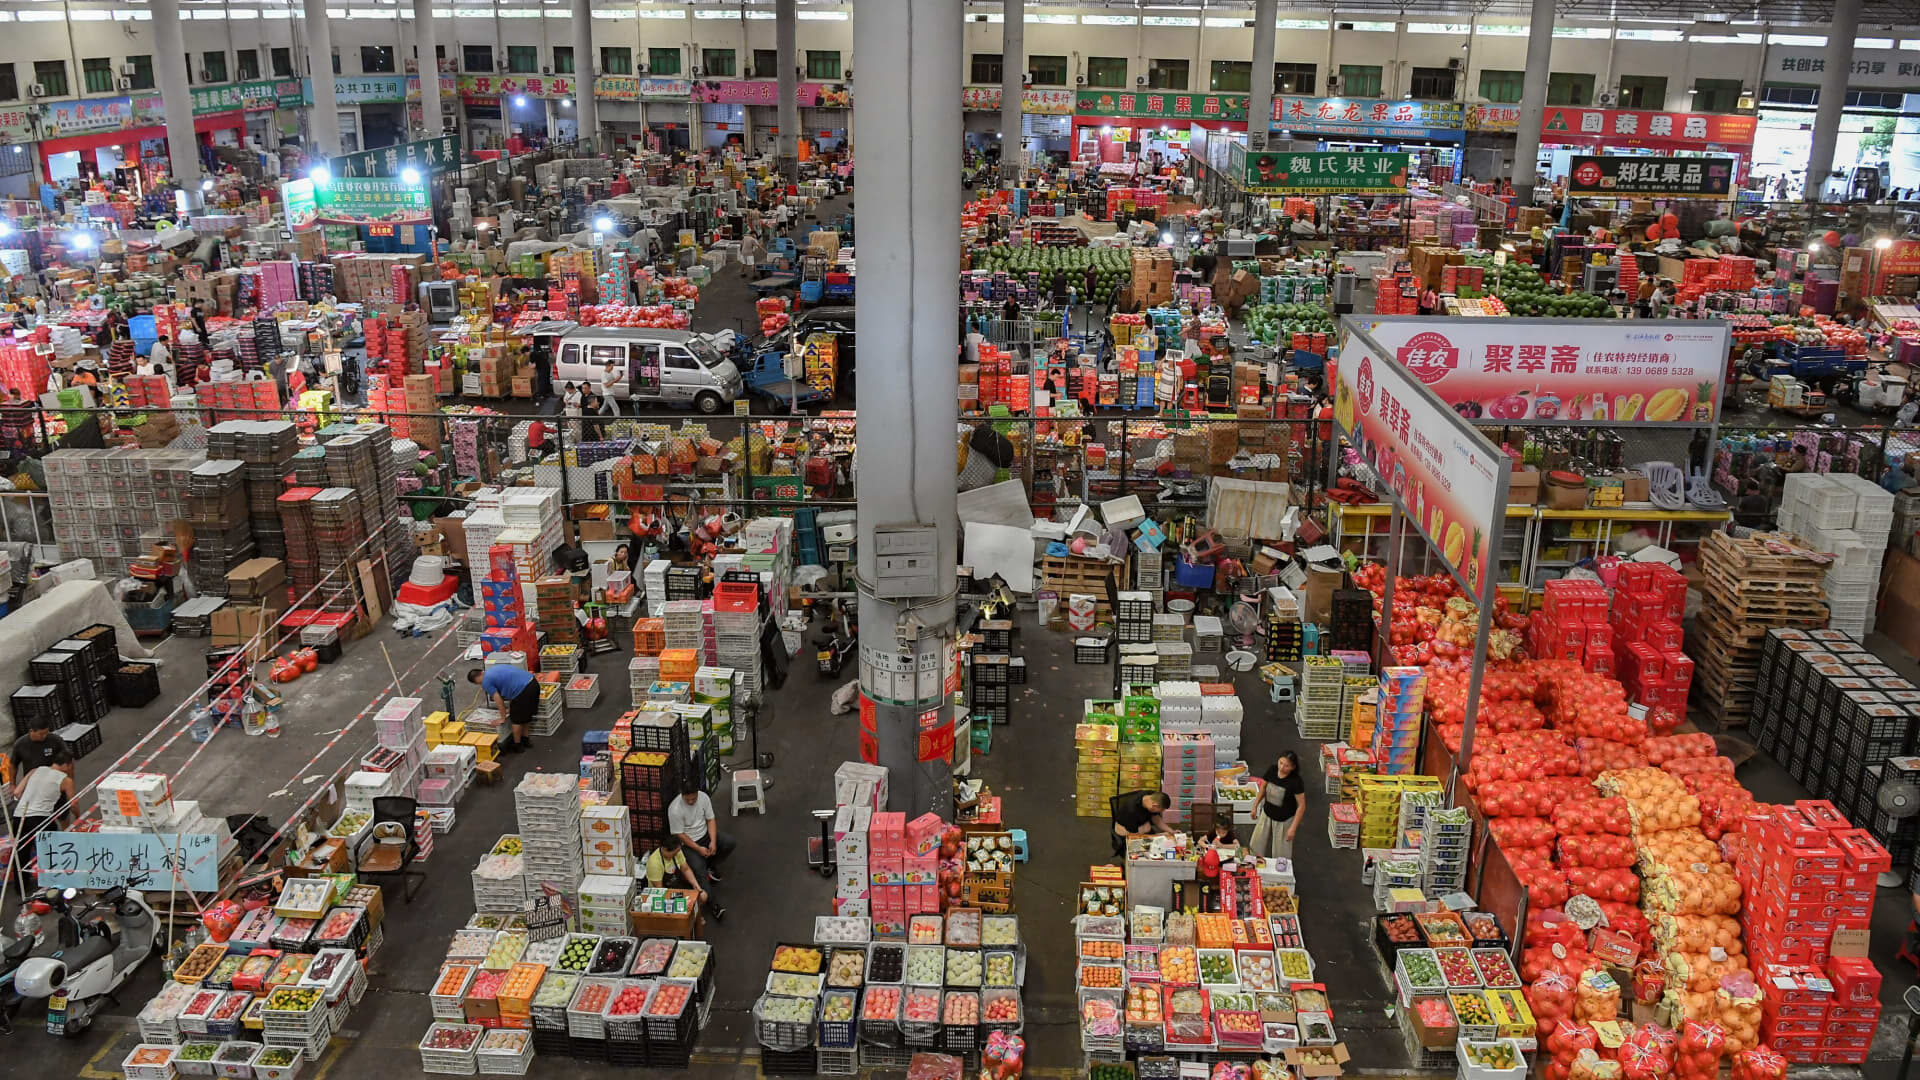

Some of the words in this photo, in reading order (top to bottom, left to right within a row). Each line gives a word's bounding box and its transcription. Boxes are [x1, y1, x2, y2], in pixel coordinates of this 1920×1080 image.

[334, 82, 397, 94] 公共卫生间
[474, 77, 569, 94] 开心果业
[724, 83, 808, 99] 小山东业
[1119, 95, 1220, 114] 新海果品
[1581, 112, 1707, 138] 國泰果品
[344, 139, 454, 178] 小叶精品水果
[1289, 156, 1393, 174] 魏氏果业
[1618, 162, 1703, 184] 郑红果品
[1406, 349, 1449, 368] 佳农
[1482, 344, 1581, 374] 聚翠斋
[1626, 367, 1642, 375] 139
[1645, 367, 1668, 376] 0689
[1671, 367, 1694, 376] 5328
[1379, 386, 1412, 447] 聚翠斋
[920, 660, 936, 669] 012
[190, 836, 211, 848] 16#
